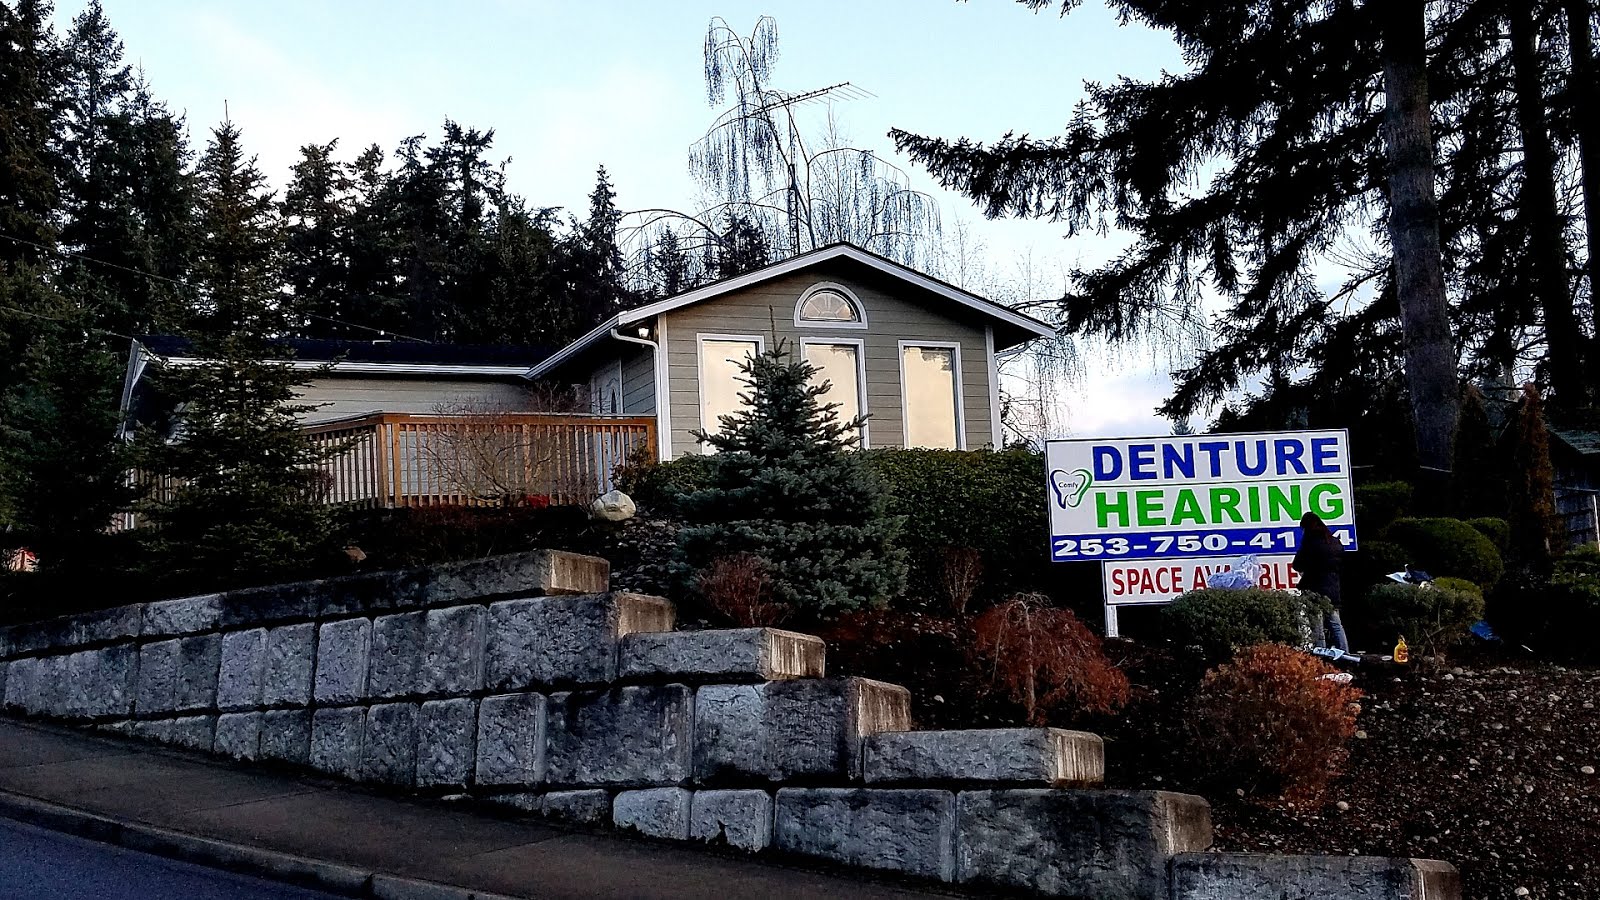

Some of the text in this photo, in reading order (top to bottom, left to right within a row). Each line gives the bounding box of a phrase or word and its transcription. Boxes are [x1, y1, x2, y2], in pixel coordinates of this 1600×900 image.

[1092, 437, 1341, 482] DENTURE
[1058, 481, 1079, 489] Comfy
[1095, 483, 1344, 528] HEARING
[1053, 529, 1354, 557] 253-750-414
[1111, 566, 1184, 596] SPACE
